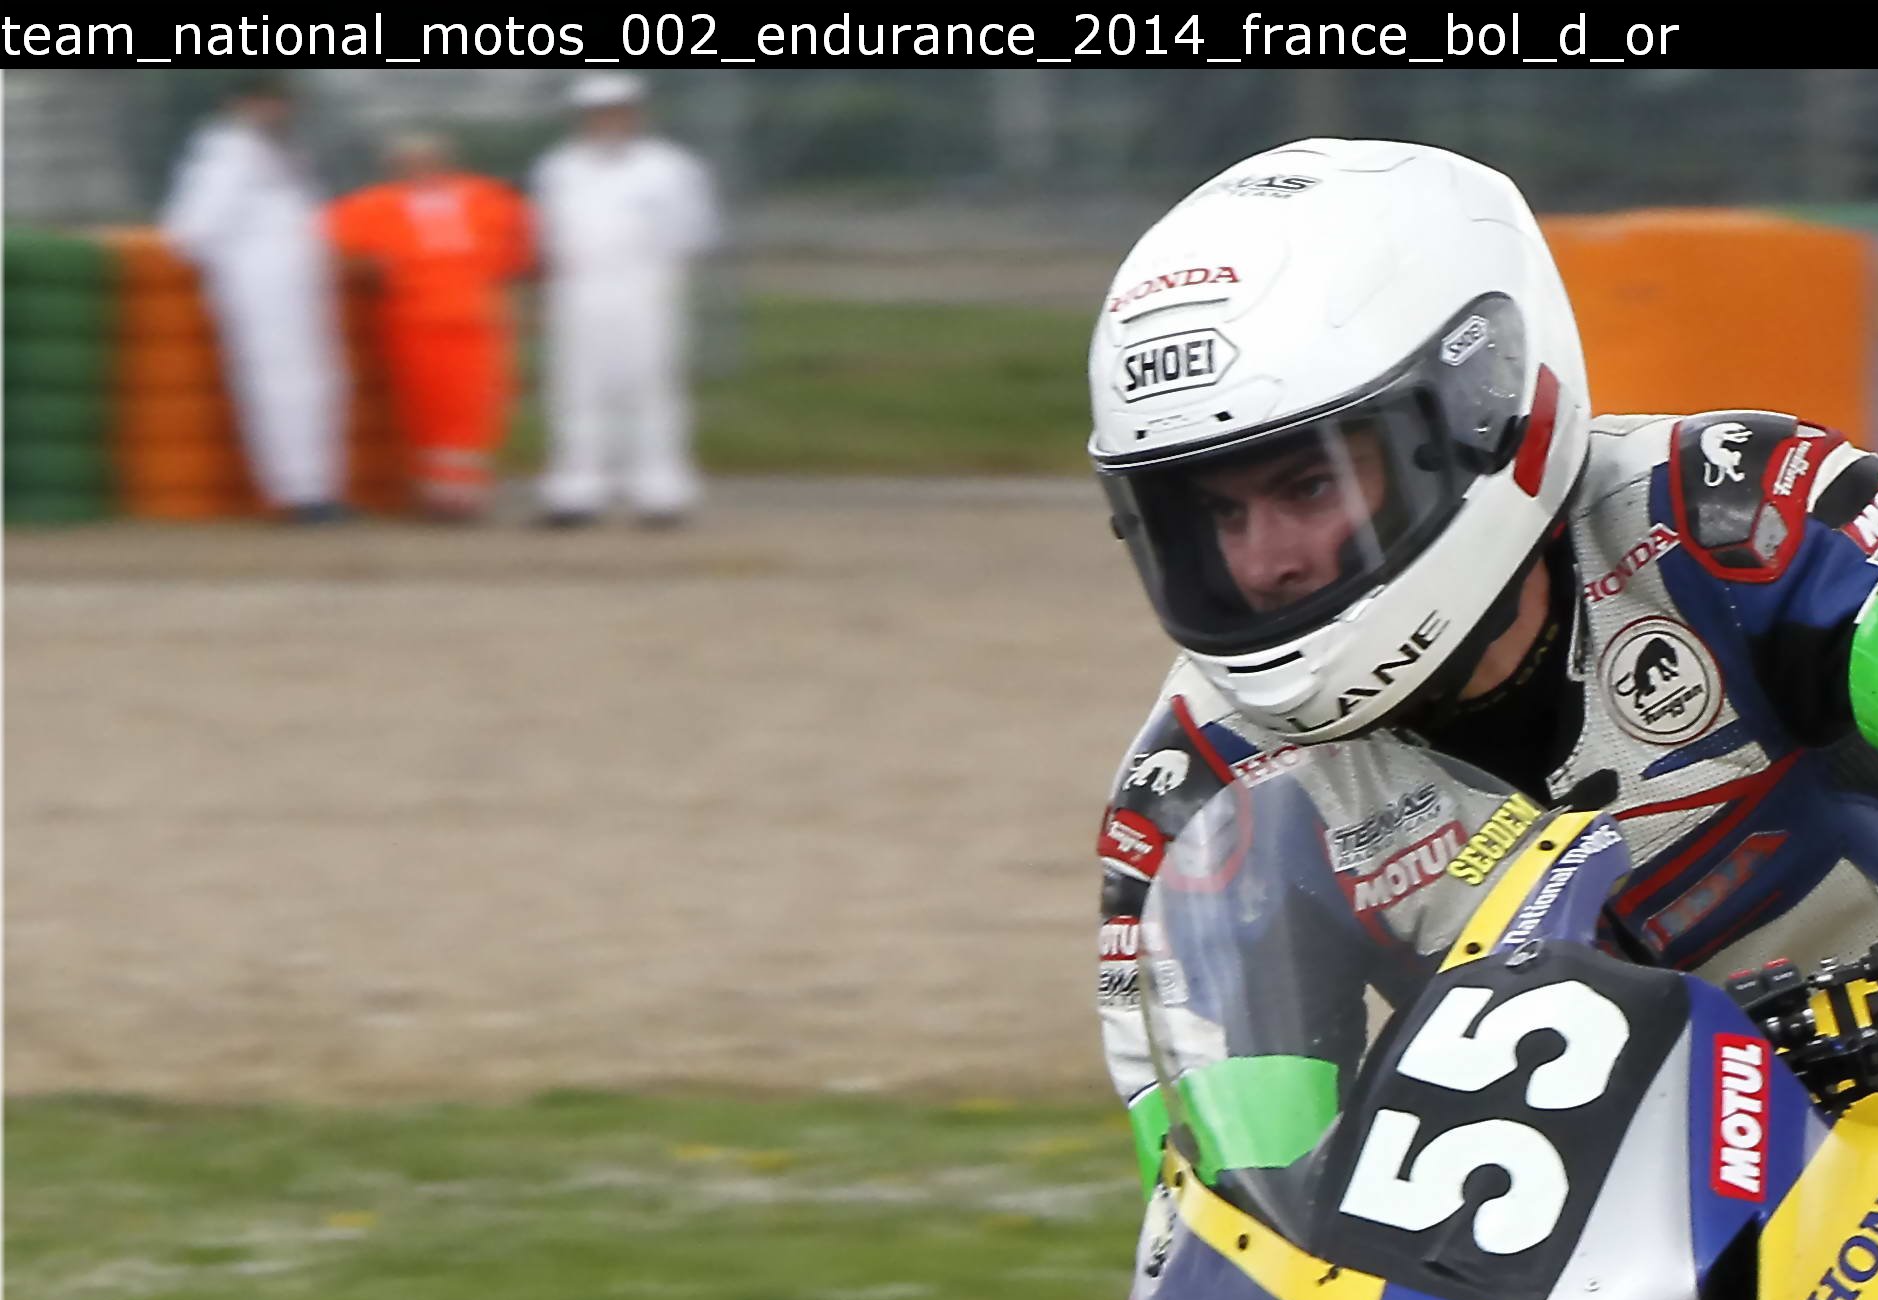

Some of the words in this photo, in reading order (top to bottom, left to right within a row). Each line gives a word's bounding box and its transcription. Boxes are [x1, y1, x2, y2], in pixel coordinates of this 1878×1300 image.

[1109, 266, 1241, 313] HONDA
[1125, 338, 1215, 392] SHOEI
[1583, 528, 1681, 604] HONDA
[1286, 608, 1451, 733] LANE
[1353, 828, 1467, 912] MOTUL
[1338, 979, 1631, 1255] 55
[1719, 1042, 1764, 1194] MOTUL
